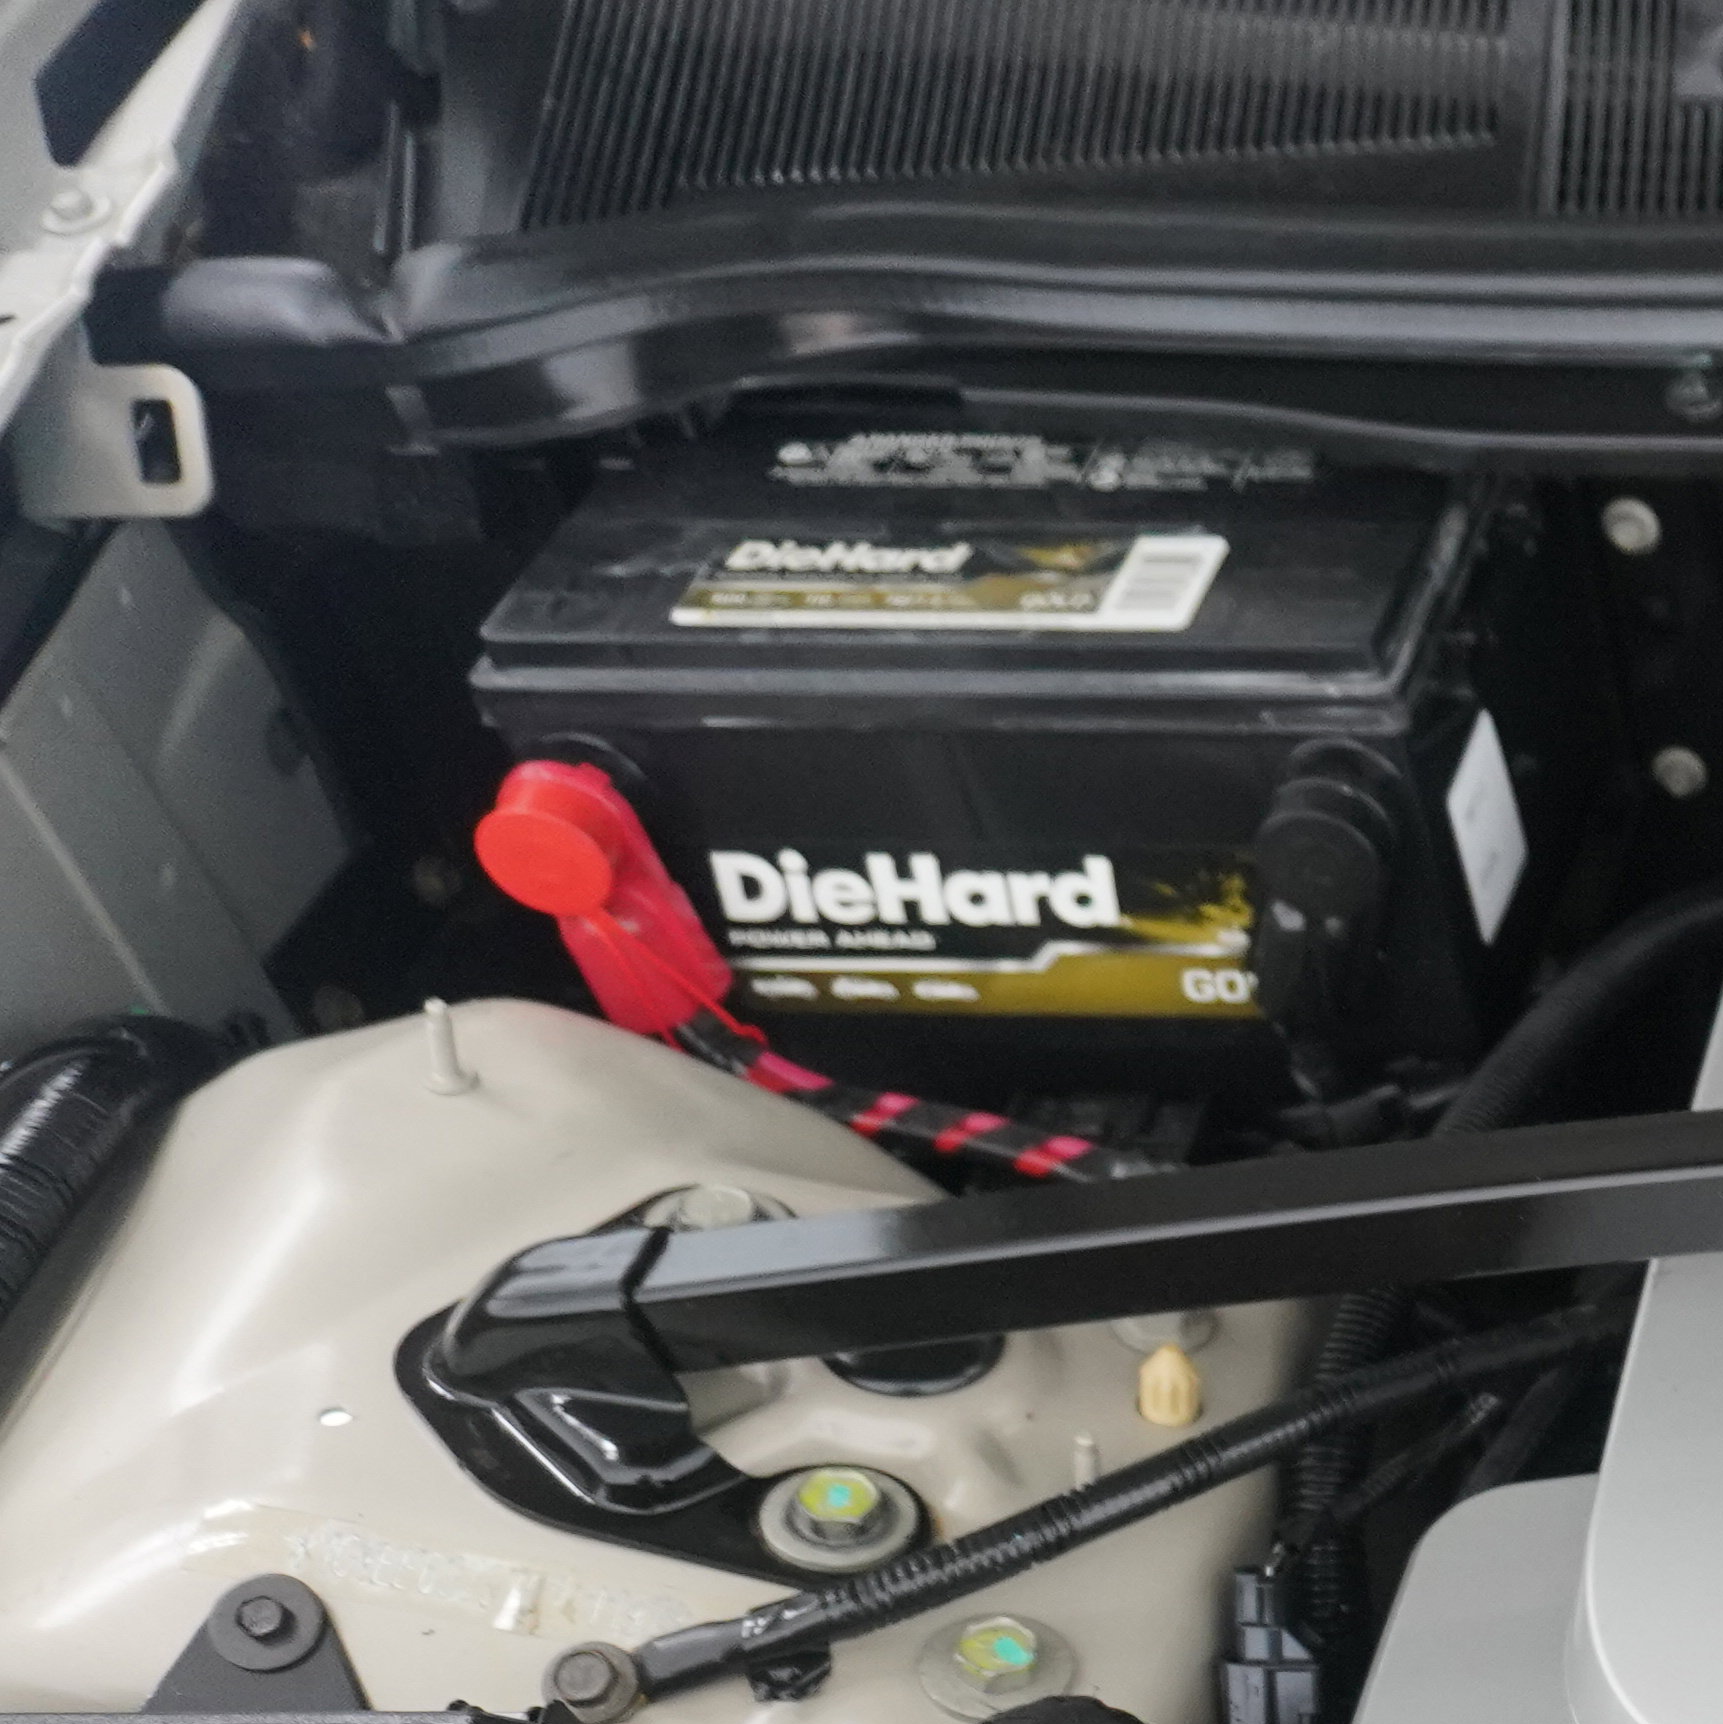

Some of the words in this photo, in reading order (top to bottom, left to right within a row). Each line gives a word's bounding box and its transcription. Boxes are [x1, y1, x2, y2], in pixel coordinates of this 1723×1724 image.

[725, 540, 971, 577] DieHard
[710, 849, 1118, 927] DieHard
[1180, 967, 1257, 1004] GO
